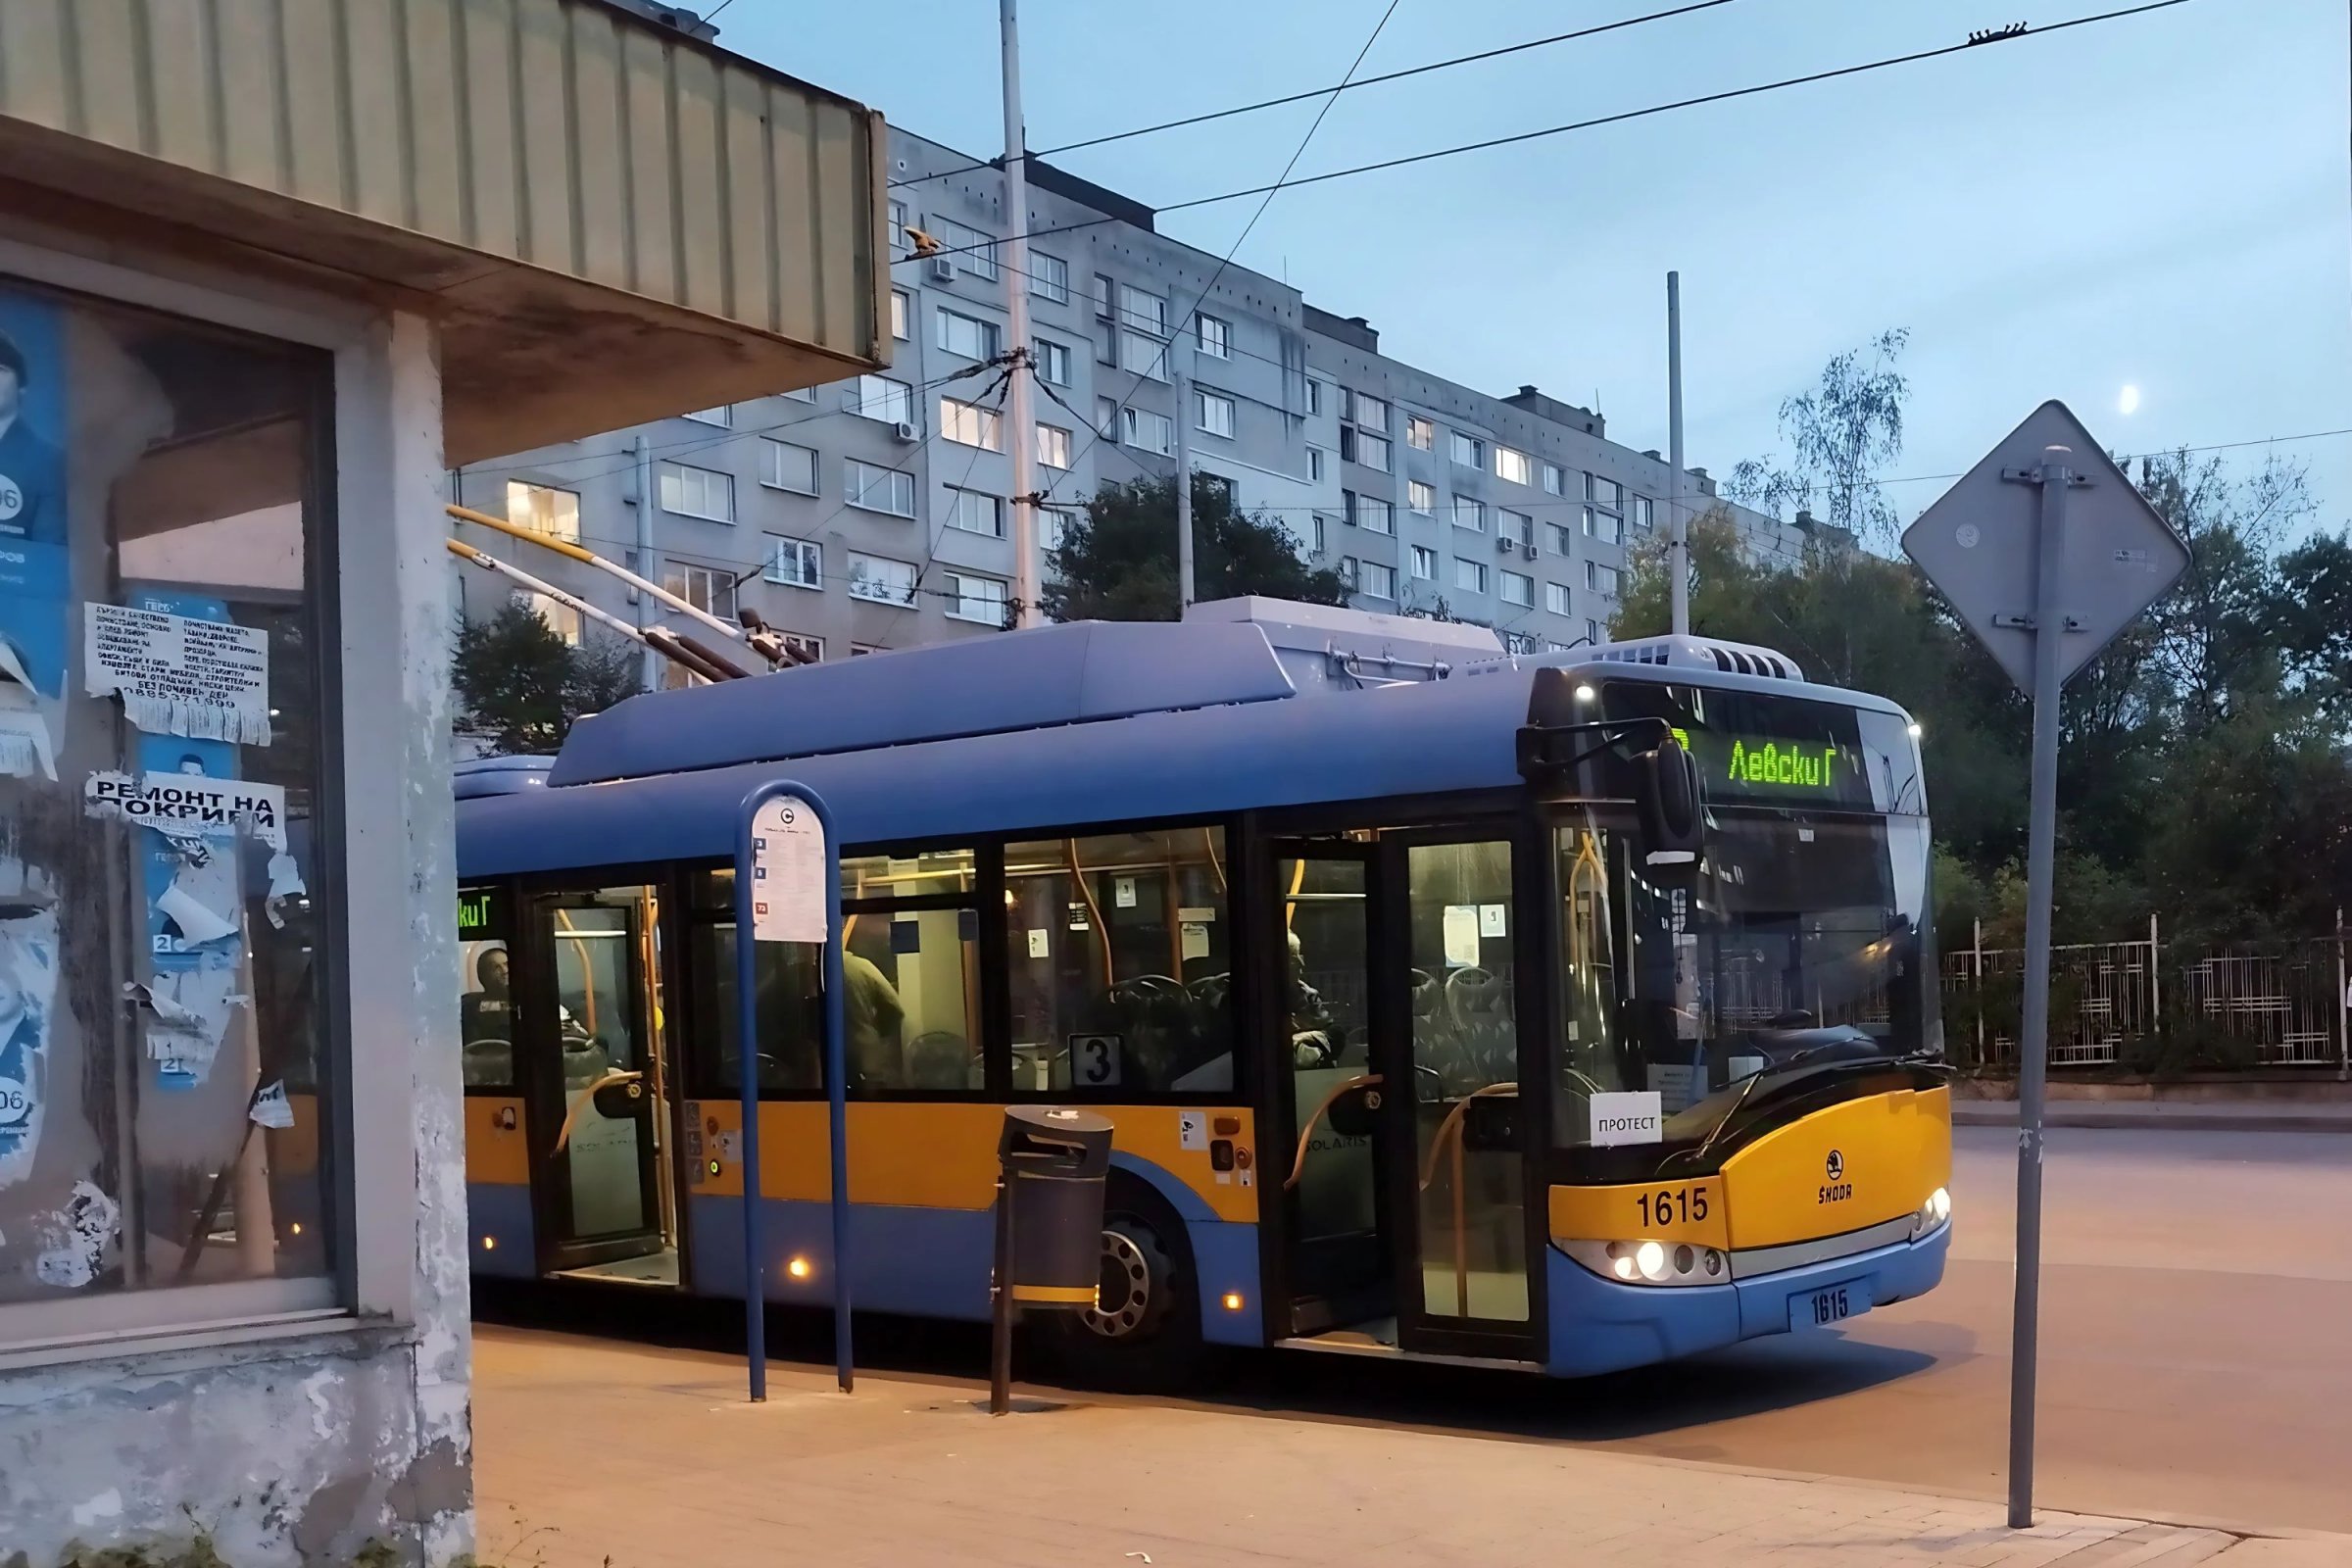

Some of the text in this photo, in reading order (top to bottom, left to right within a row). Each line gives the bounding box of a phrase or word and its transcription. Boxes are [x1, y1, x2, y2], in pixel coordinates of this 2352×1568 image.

[138, 680, 156, 690] БЕЗ
[159, 683, 205, 696] ПОЧИВЕН
[1825, 748, 1837, 787] Г
[97, 781, 273, 813] РЕМОНТ НА
[481, 896, 491, 926] Г
[157, 937, 169, 950] 2
[1086, 1041, 1111, 1084] 3
[1598, 1116, 1655, 1134] ПРОТЕСТ
[1637, 1187, 1708, 1228] 1615
[1818, 1183, 1853, 1205] ŠKODA
[1811, 1290, 1848, 1325] 1615
